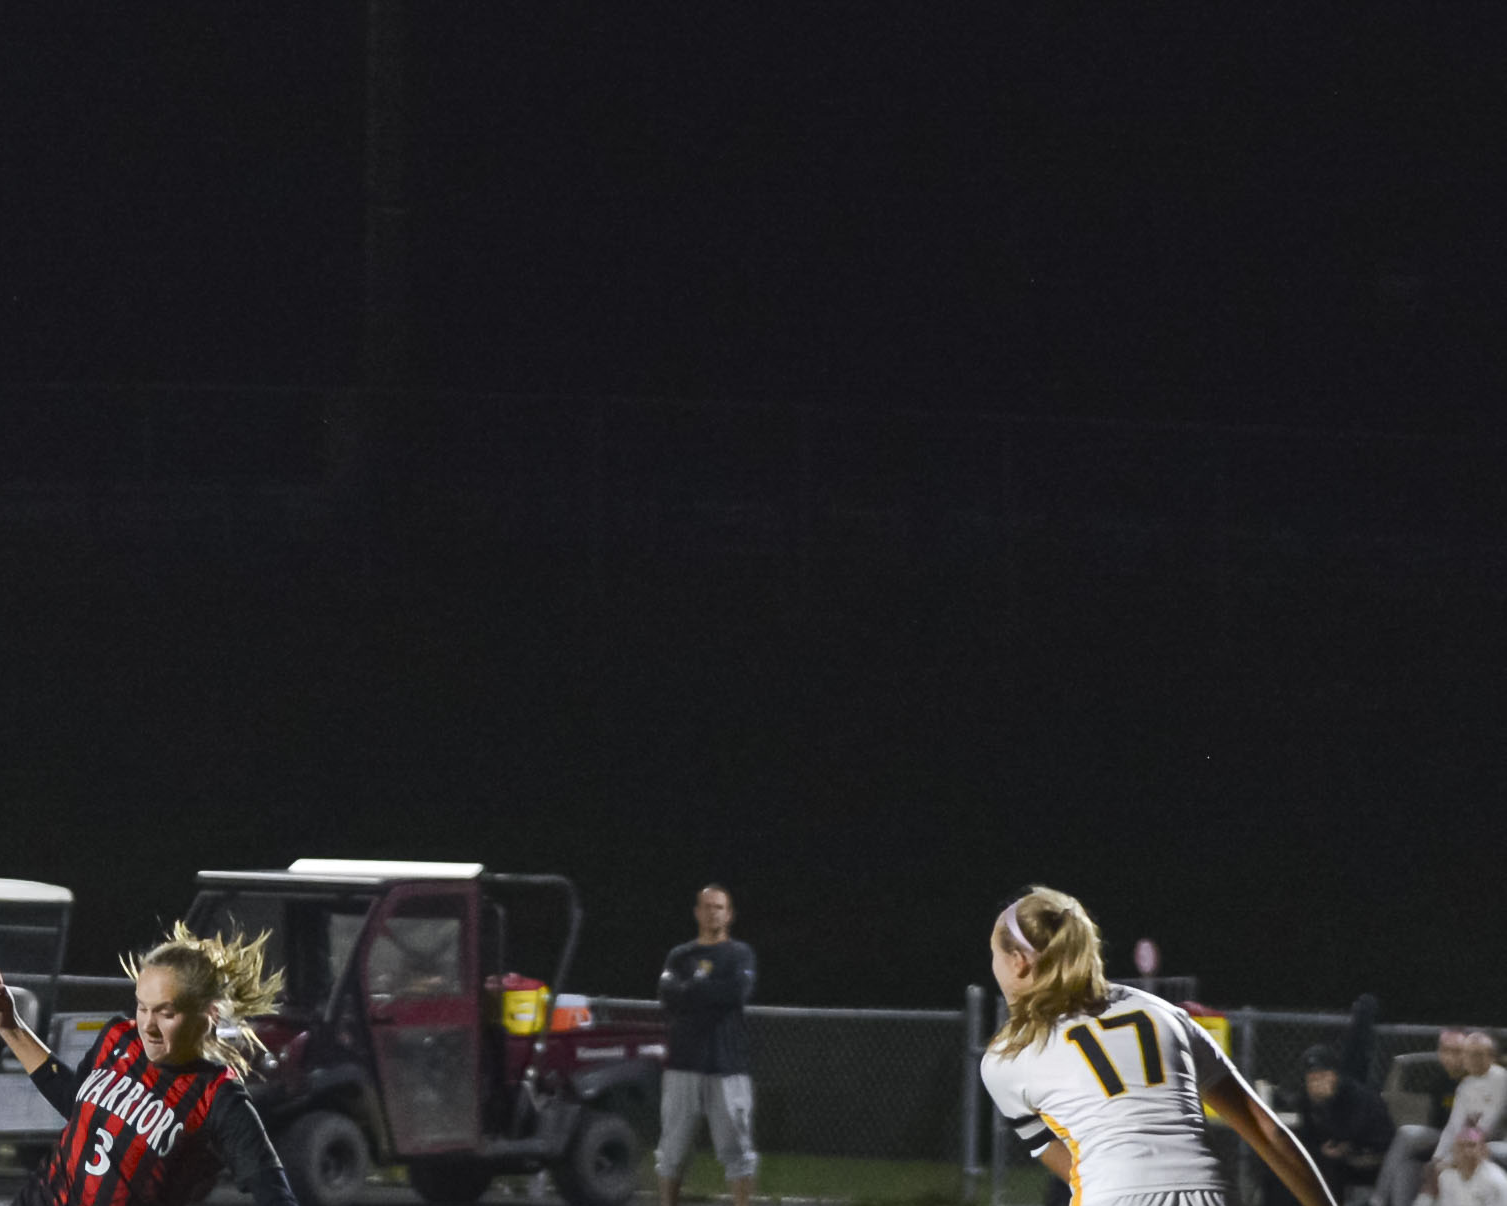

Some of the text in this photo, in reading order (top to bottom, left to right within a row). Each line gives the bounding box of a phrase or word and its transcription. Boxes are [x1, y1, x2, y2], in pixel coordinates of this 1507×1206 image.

[1063, 1009, 1167, 1099] 17
[75, 1068, 185, 1157] WARRIORS
[84, 1127, 114, 1176] 3
